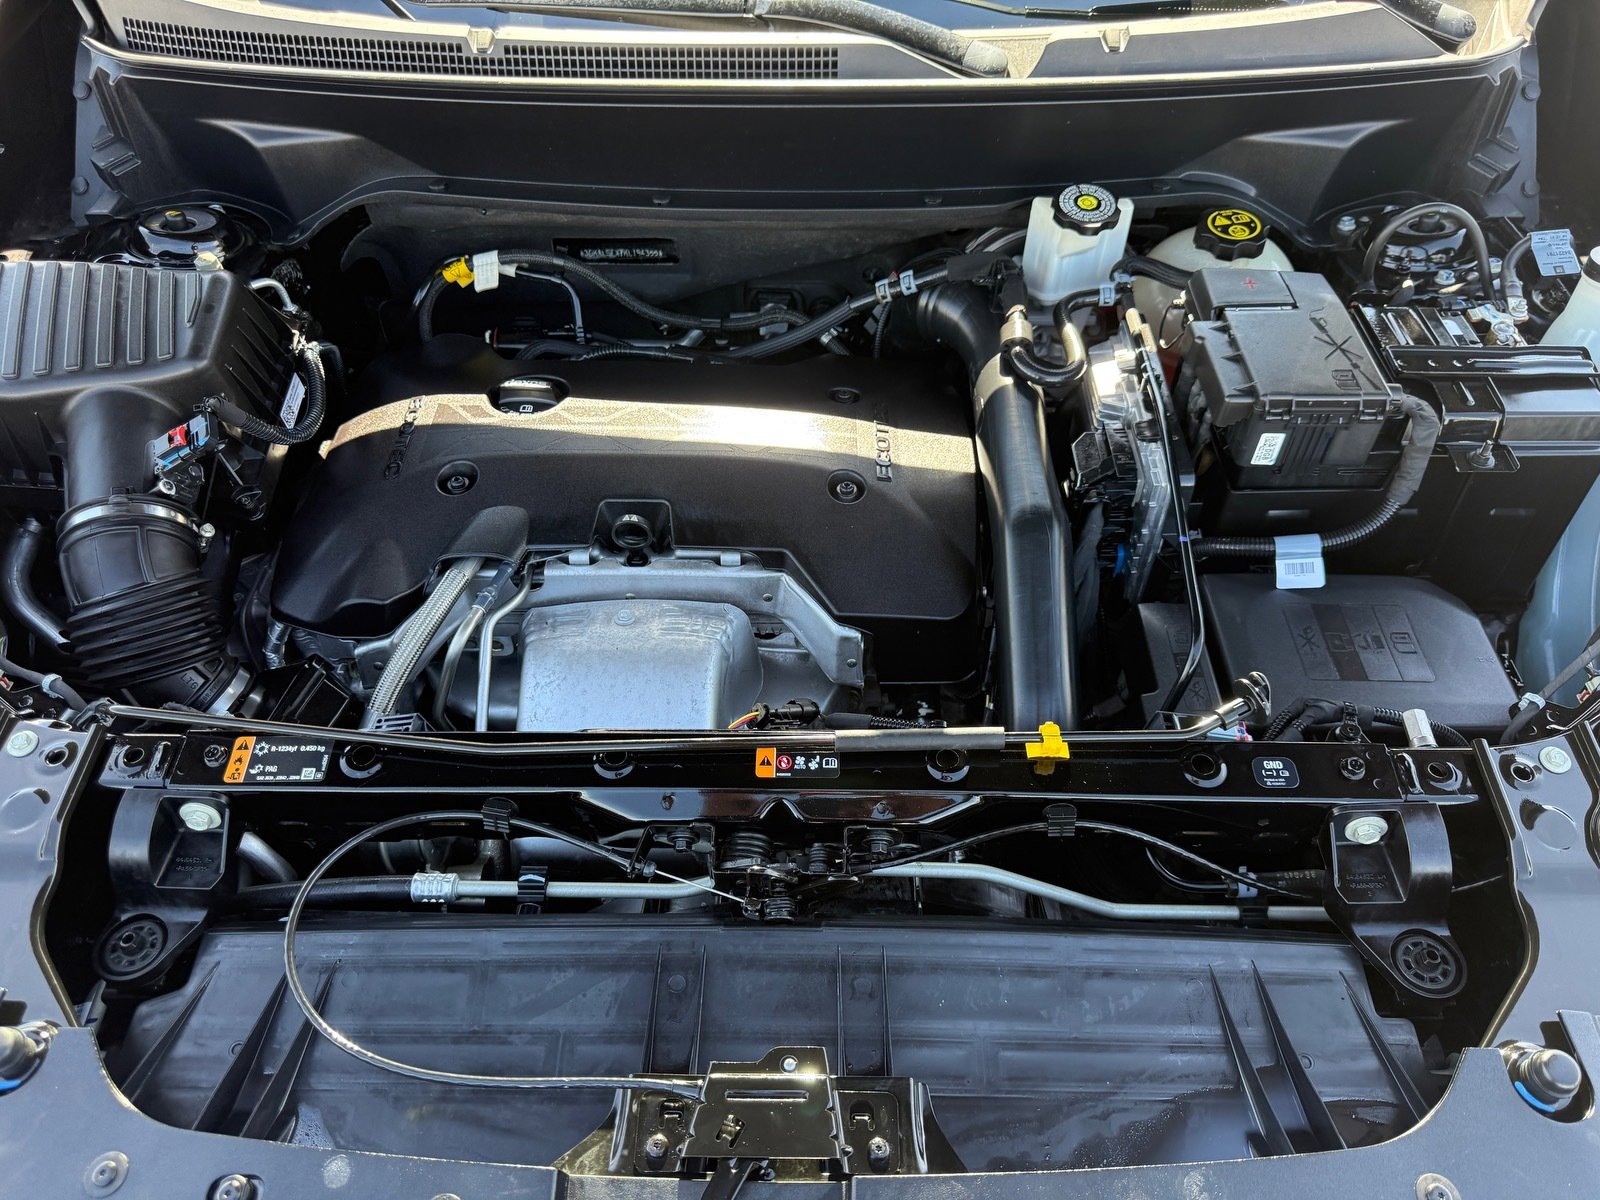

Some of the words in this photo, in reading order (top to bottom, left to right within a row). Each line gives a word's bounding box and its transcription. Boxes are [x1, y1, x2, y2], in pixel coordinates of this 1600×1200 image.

[874, 401, 893, 482] ECOT
[265, 765, 278, 773] PAG
[1263, 760, 1283, 770] GND
